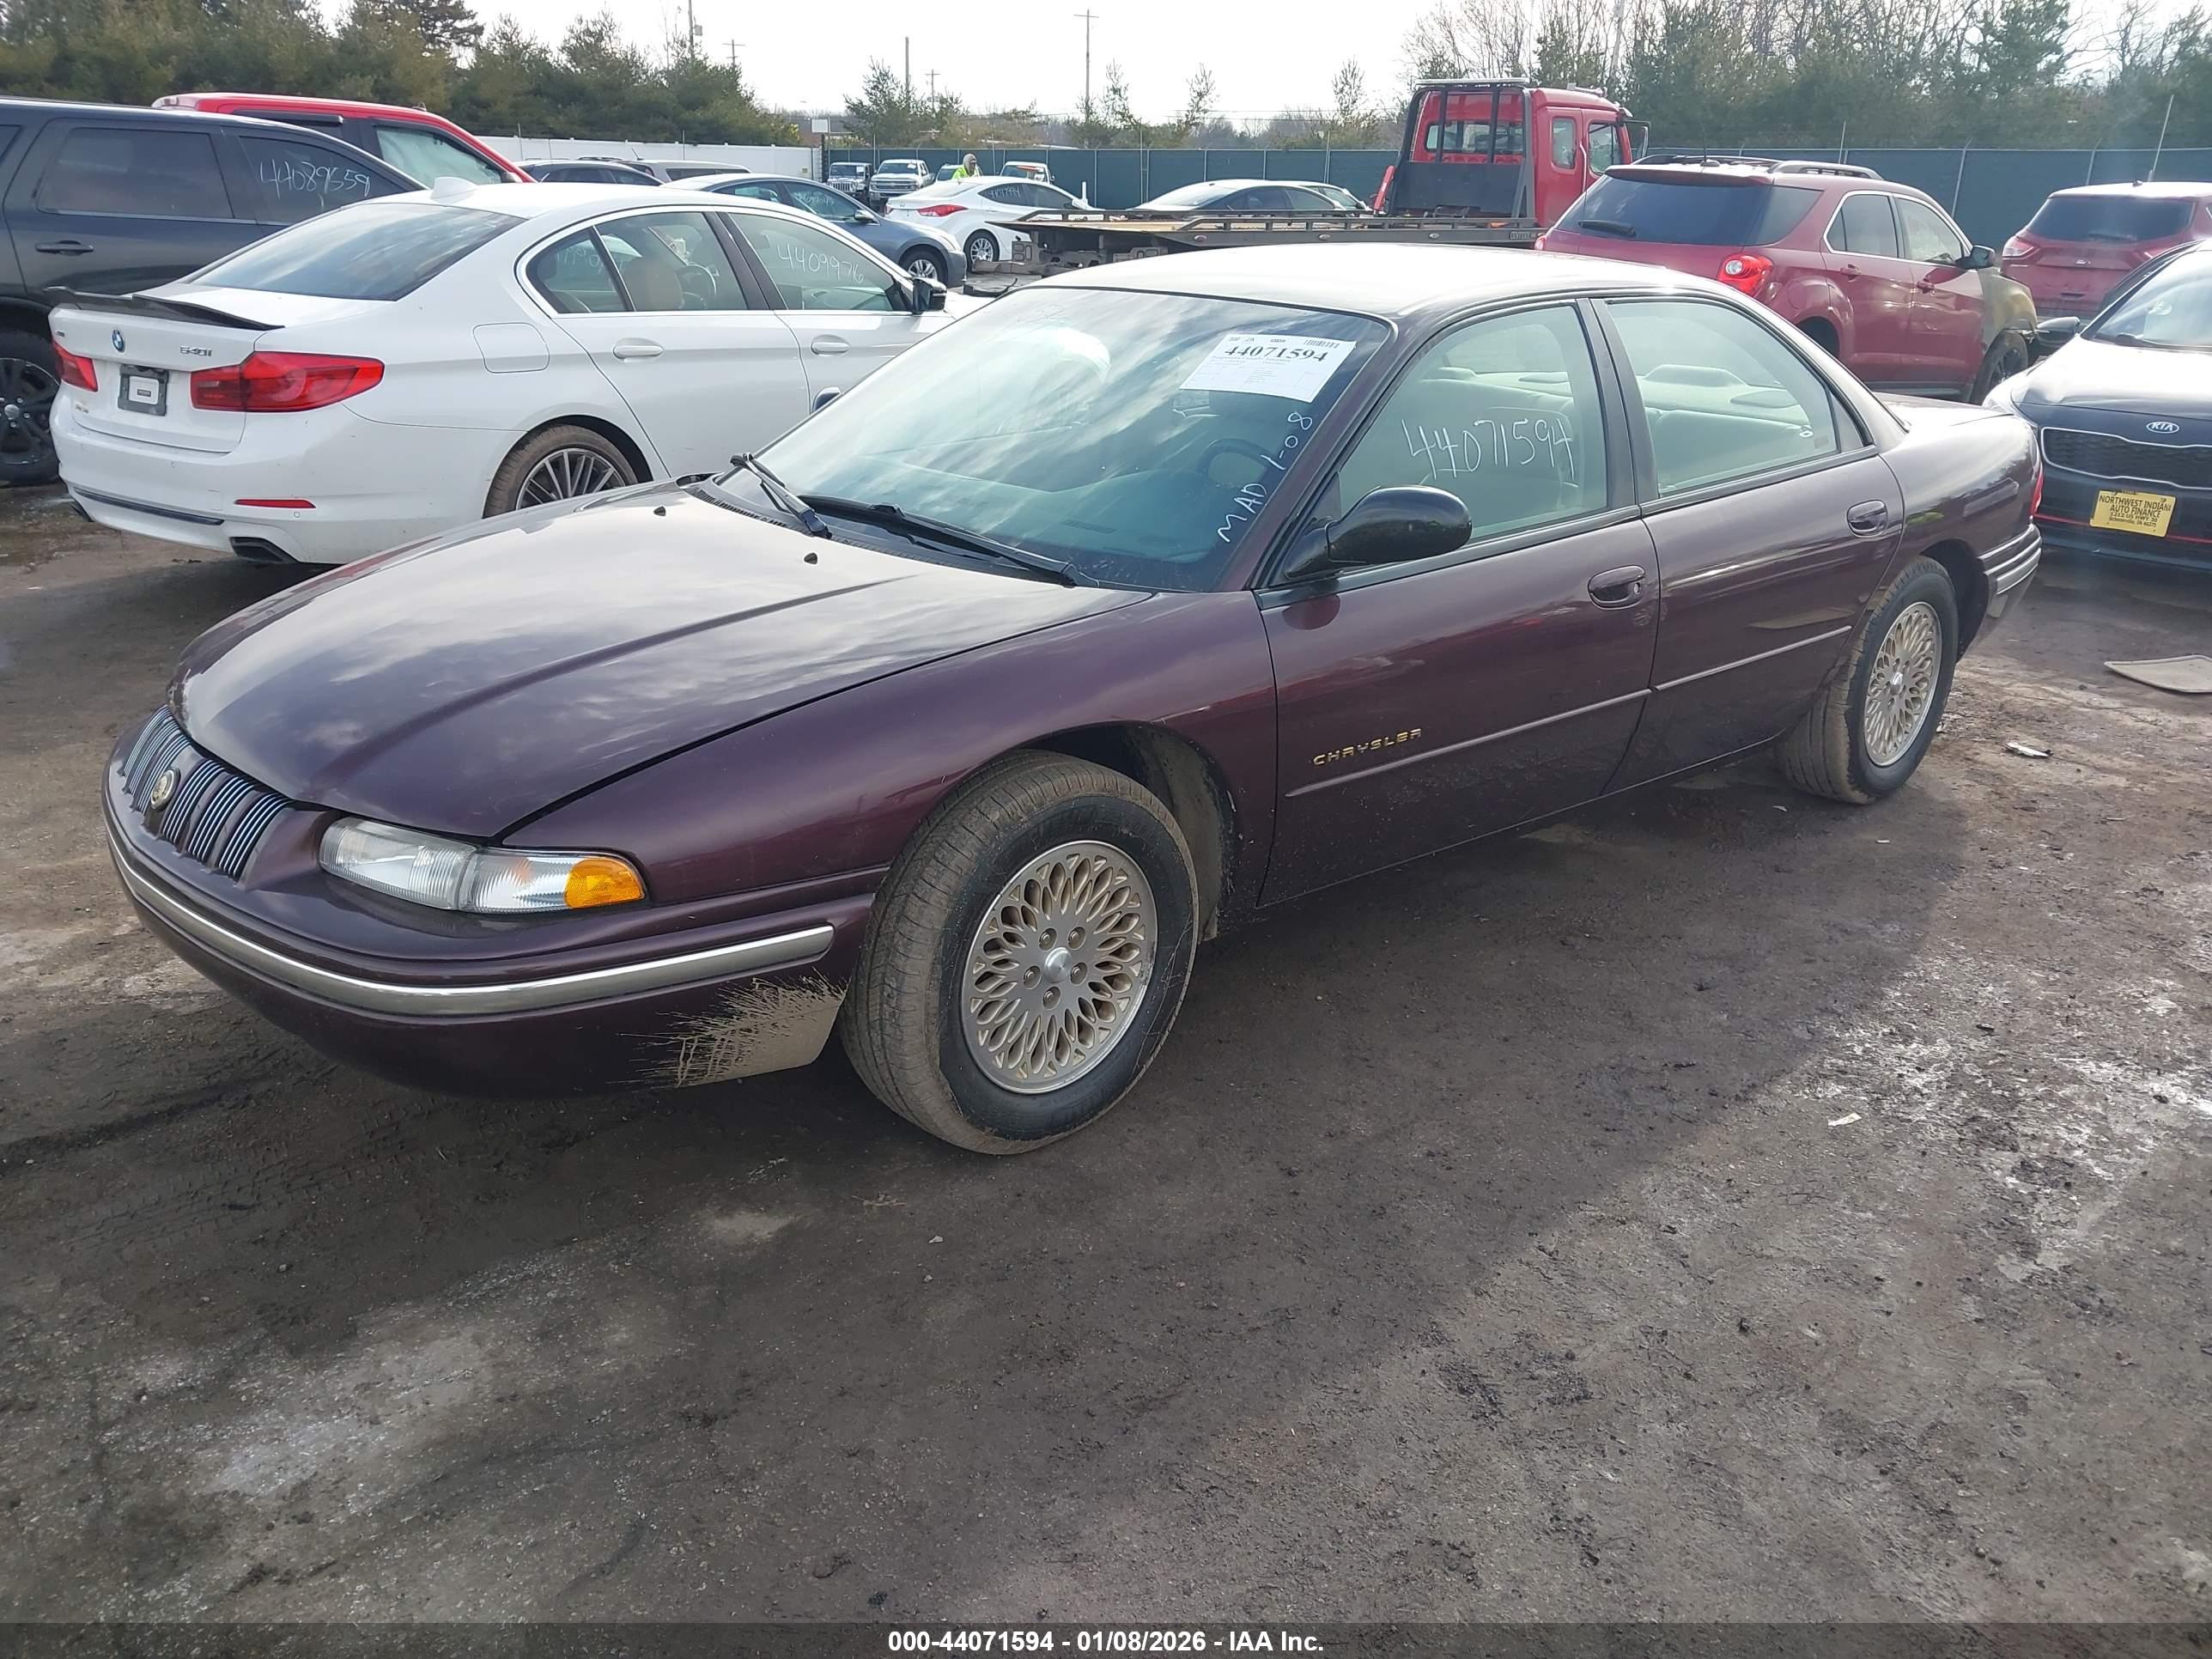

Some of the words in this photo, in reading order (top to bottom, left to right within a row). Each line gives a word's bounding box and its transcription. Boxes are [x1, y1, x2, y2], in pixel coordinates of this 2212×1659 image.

[1224, 345, 1328, 362] 44071594
[1401, 418, 1575, 480] 44071594
[1217, 483, 1267, 543] MAD
[2099, 495, 2143, 507] NORTHWEST
[2109, 504, 2130, 514] AUTO
[2130, 507, 2161, 518] FINANCE
[1313, 728, 1422, 766] CHRYSLER
